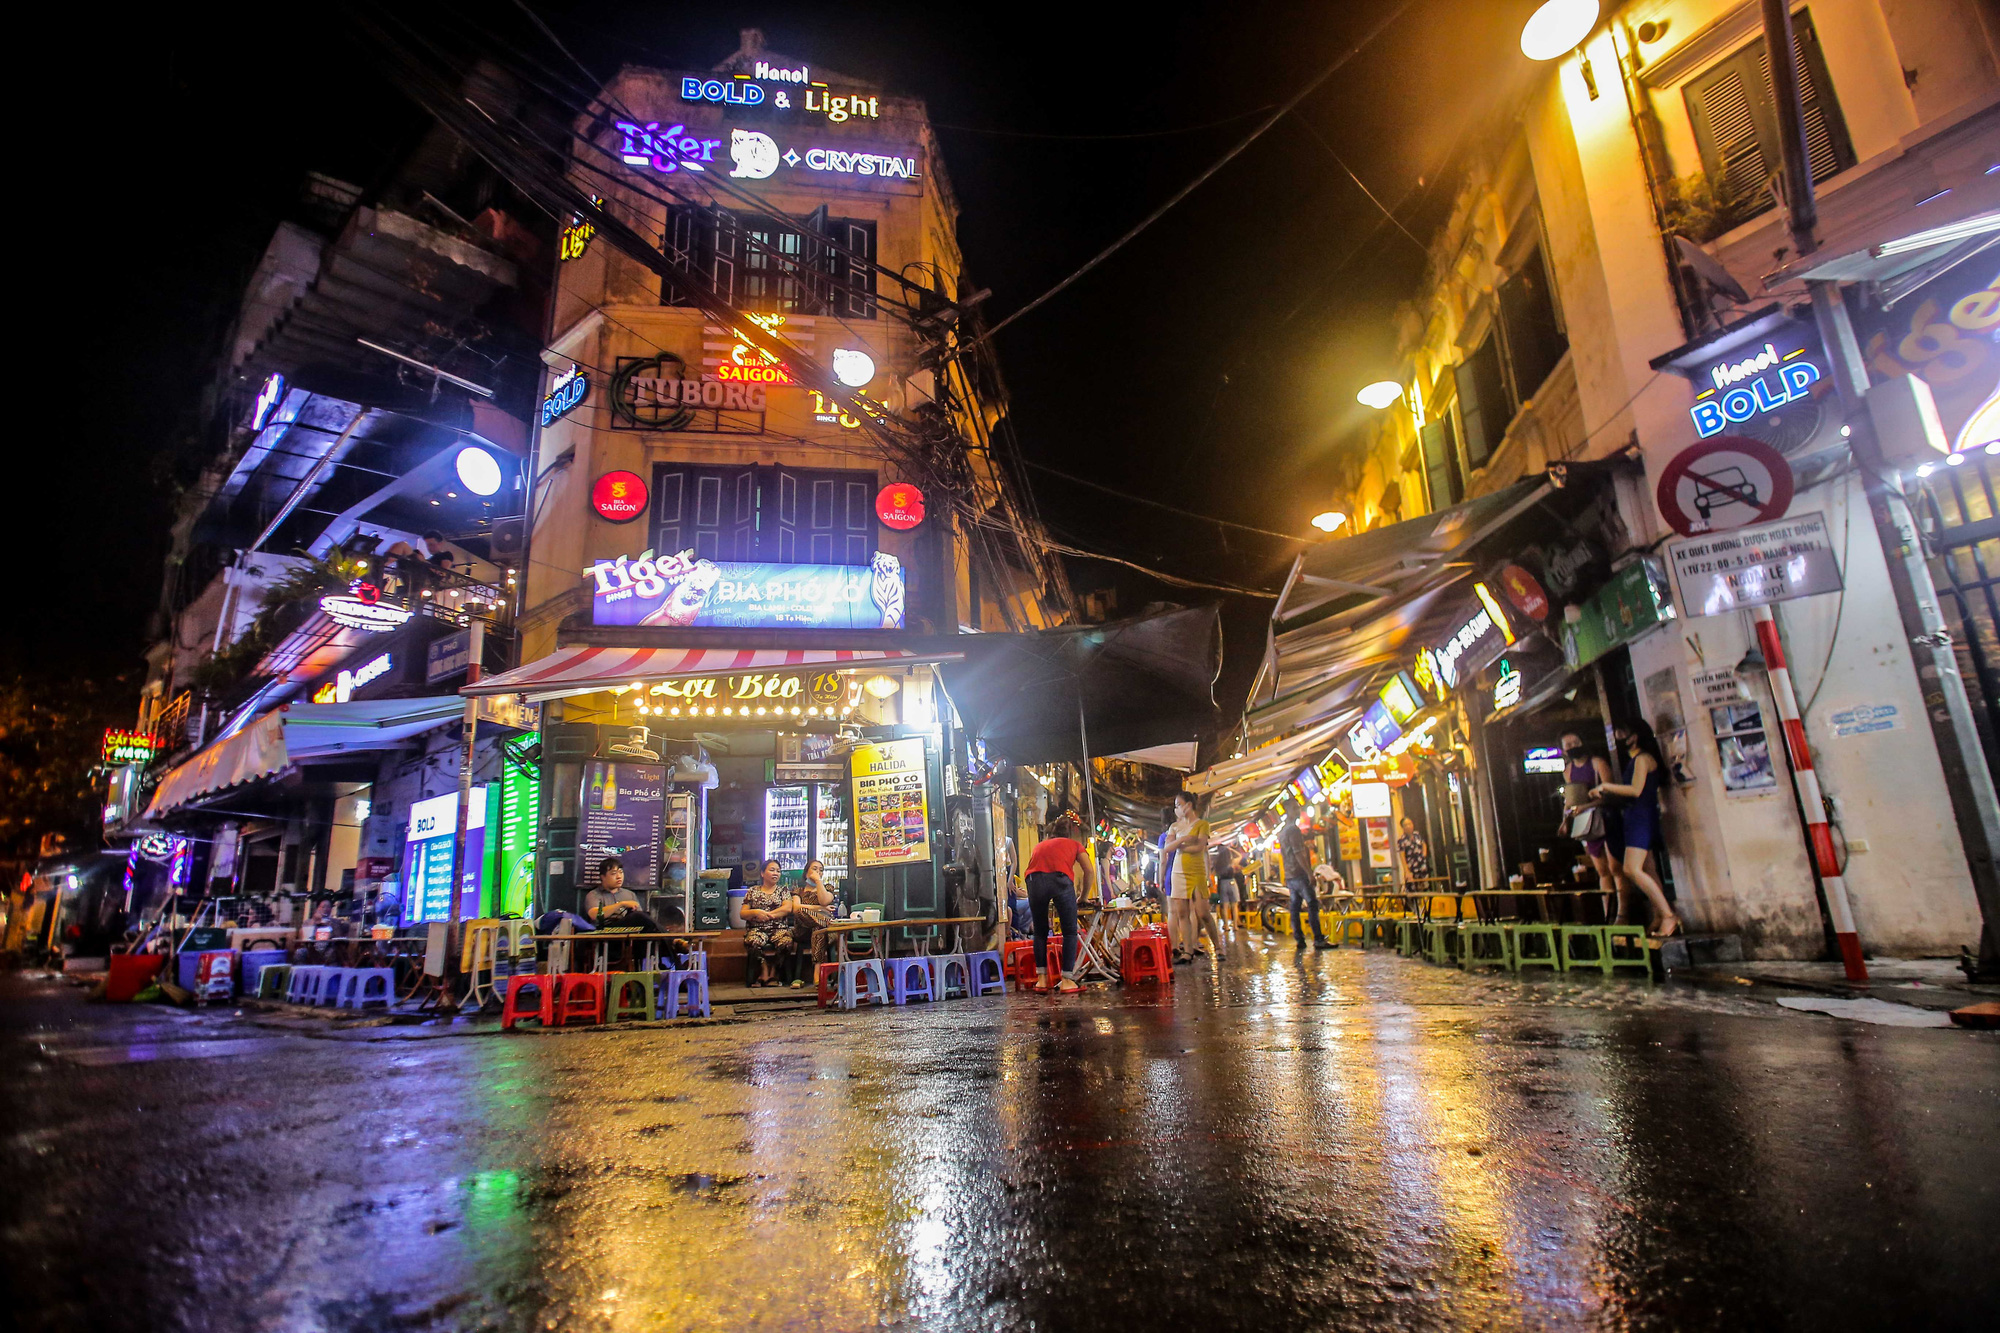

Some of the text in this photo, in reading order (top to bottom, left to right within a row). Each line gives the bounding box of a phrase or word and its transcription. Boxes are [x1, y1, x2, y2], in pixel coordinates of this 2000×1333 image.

[681, 77, 879, 124] BOLD & Light
[804, 149, 921, 180] CRYSTAL
[744, 358, 764, 367] BIA
[1711, 342, 1780, 390] Hanoi
[718, 365, 788, 383] SAIGON
[541, 376, 586, 426] BOLD
[630, 375, 767, 413] TUBORG
[1689, 361, 1821, 439] BOLD
[816, 415, 838, 423] SINCE
[601, 503, 636, 512] SAIGON
[883, 512, 916, 522] SAIGON
[1677, 550, 1687, 560] XE
[582, 548, 699, 599] Tiger
[718, 581, 761, 601] BIA
[748, 603, 763, 612] BIA
[775, 614, 784, 622] 18
[729, 673, 804, 699] Béo
[812, 671, 842, 693] 18
[869, 759, 907, 773] HALIDA
[643, 773, 660, 782] Light
[859, 779, 876, 788] BIA
[619, 787, 661, 798] Bia Phố Cổ
[417, 816, 436, 833] BOLD
